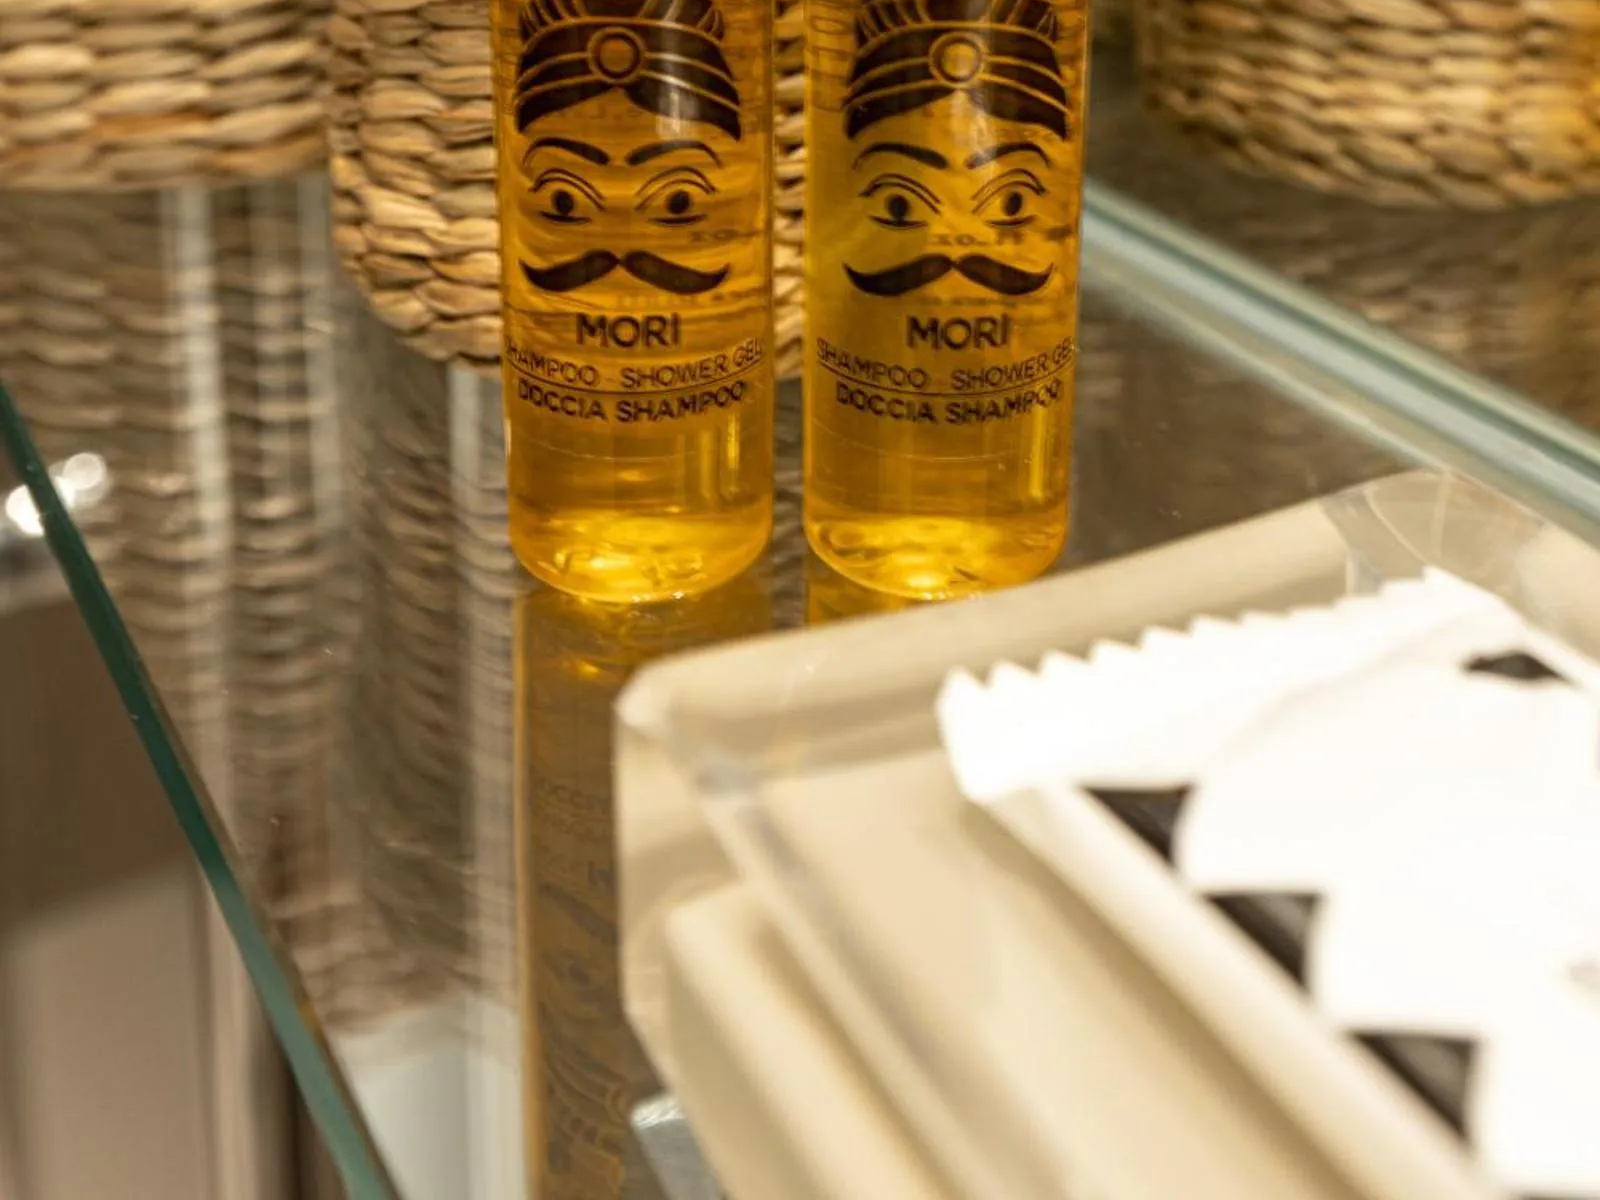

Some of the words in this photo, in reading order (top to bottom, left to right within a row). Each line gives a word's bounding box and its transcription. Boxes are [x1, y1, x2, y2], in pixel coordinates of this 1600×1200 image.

[576, 312, 681, 348] MORI
[906, 313, 1012, 349] MORI
[506, 336, 600, 386] HAMPOO
[620, 353, 727, 389] SHOWER
[817, 337, 928, 389] SHAMPOO
[951, 352, 1048, 391] SHOWER
[517, 377, 608, 422] DOCCIA
[616, 380, 747, 423] SHAMPOO
[836, 380, 938, 424] DOCCIA
